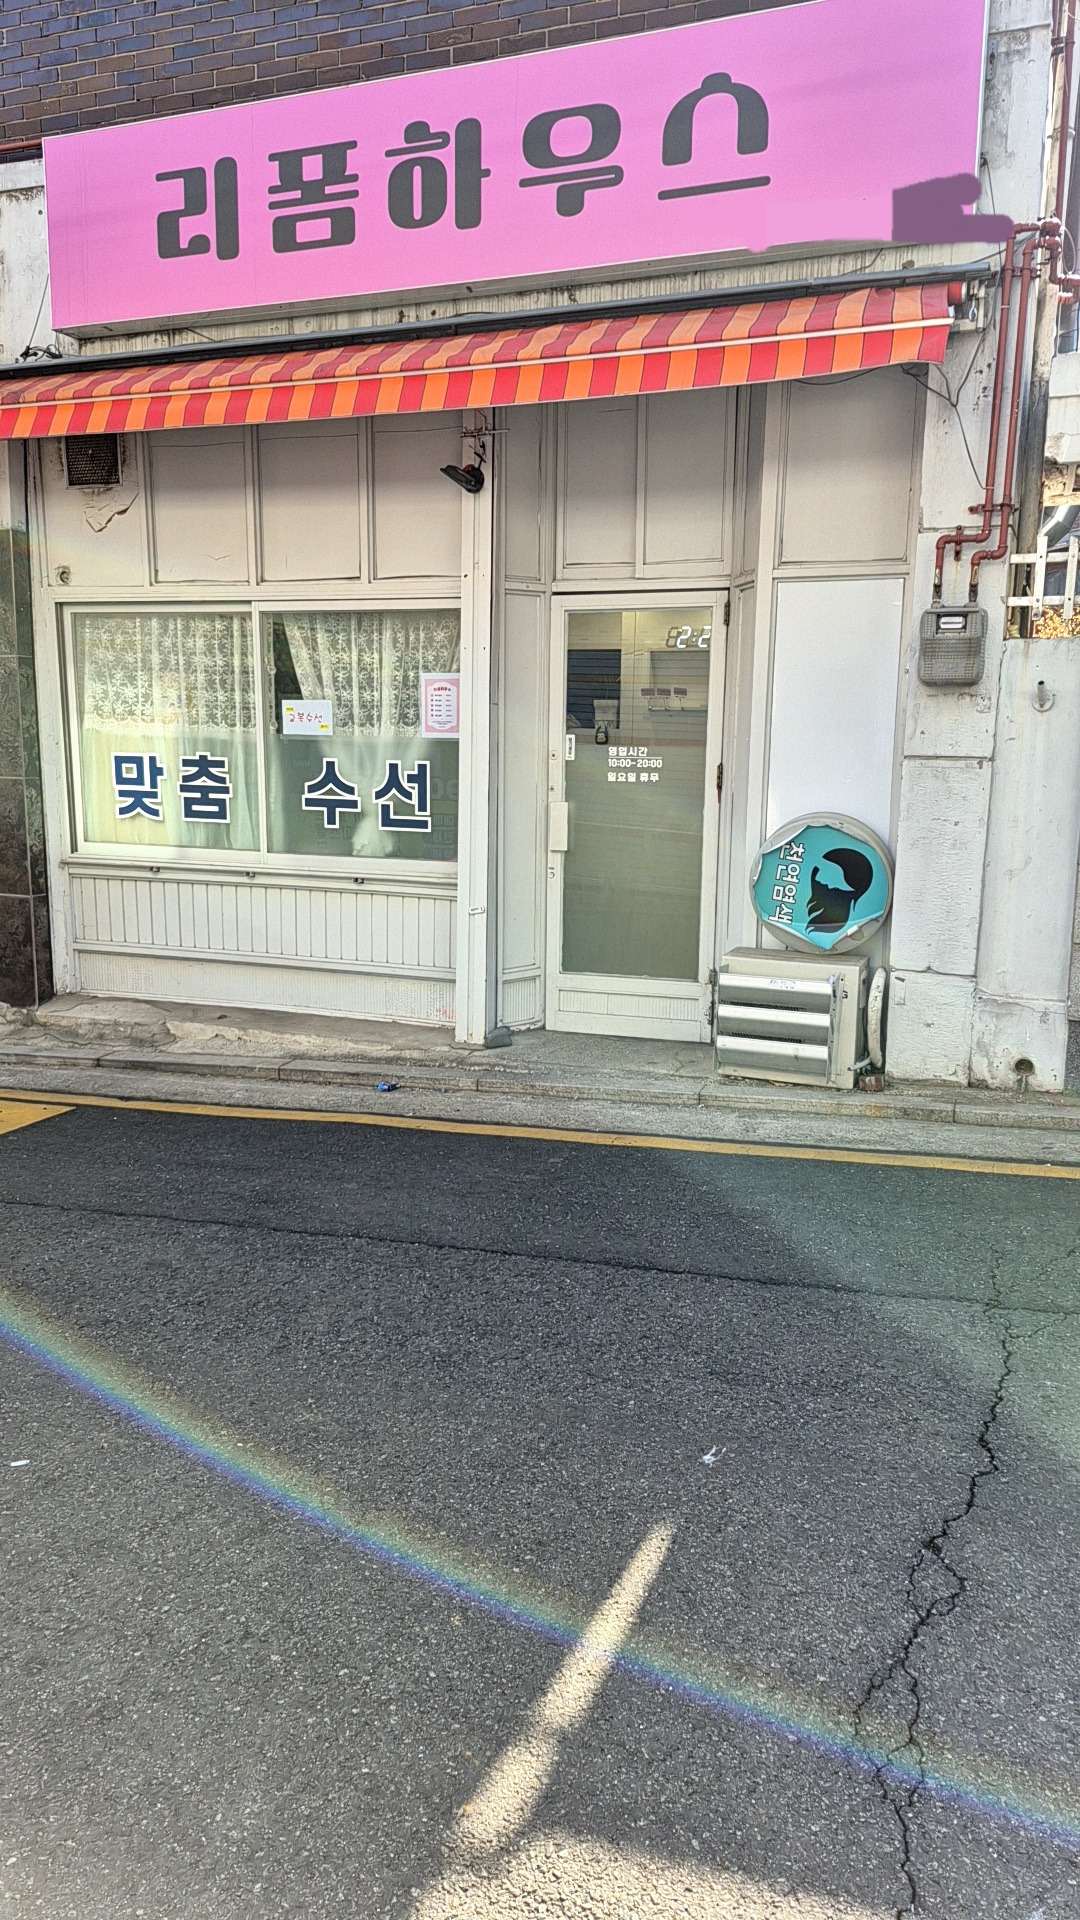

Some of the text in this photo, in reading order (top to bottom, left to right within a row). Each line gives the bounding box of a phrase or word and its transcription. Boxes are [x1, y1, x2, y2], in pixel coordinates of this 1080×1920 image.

[156, 73, 771, 261] 리폼하우스
[607, 772, 659, 782] 일요일 휴무
[608, 746, 648, 756] 영업시간
[111, 752, 233, 823] 맞춤
[302, 758, 431, 832] 수선
[768, 841, 806, 925] 천연염색
